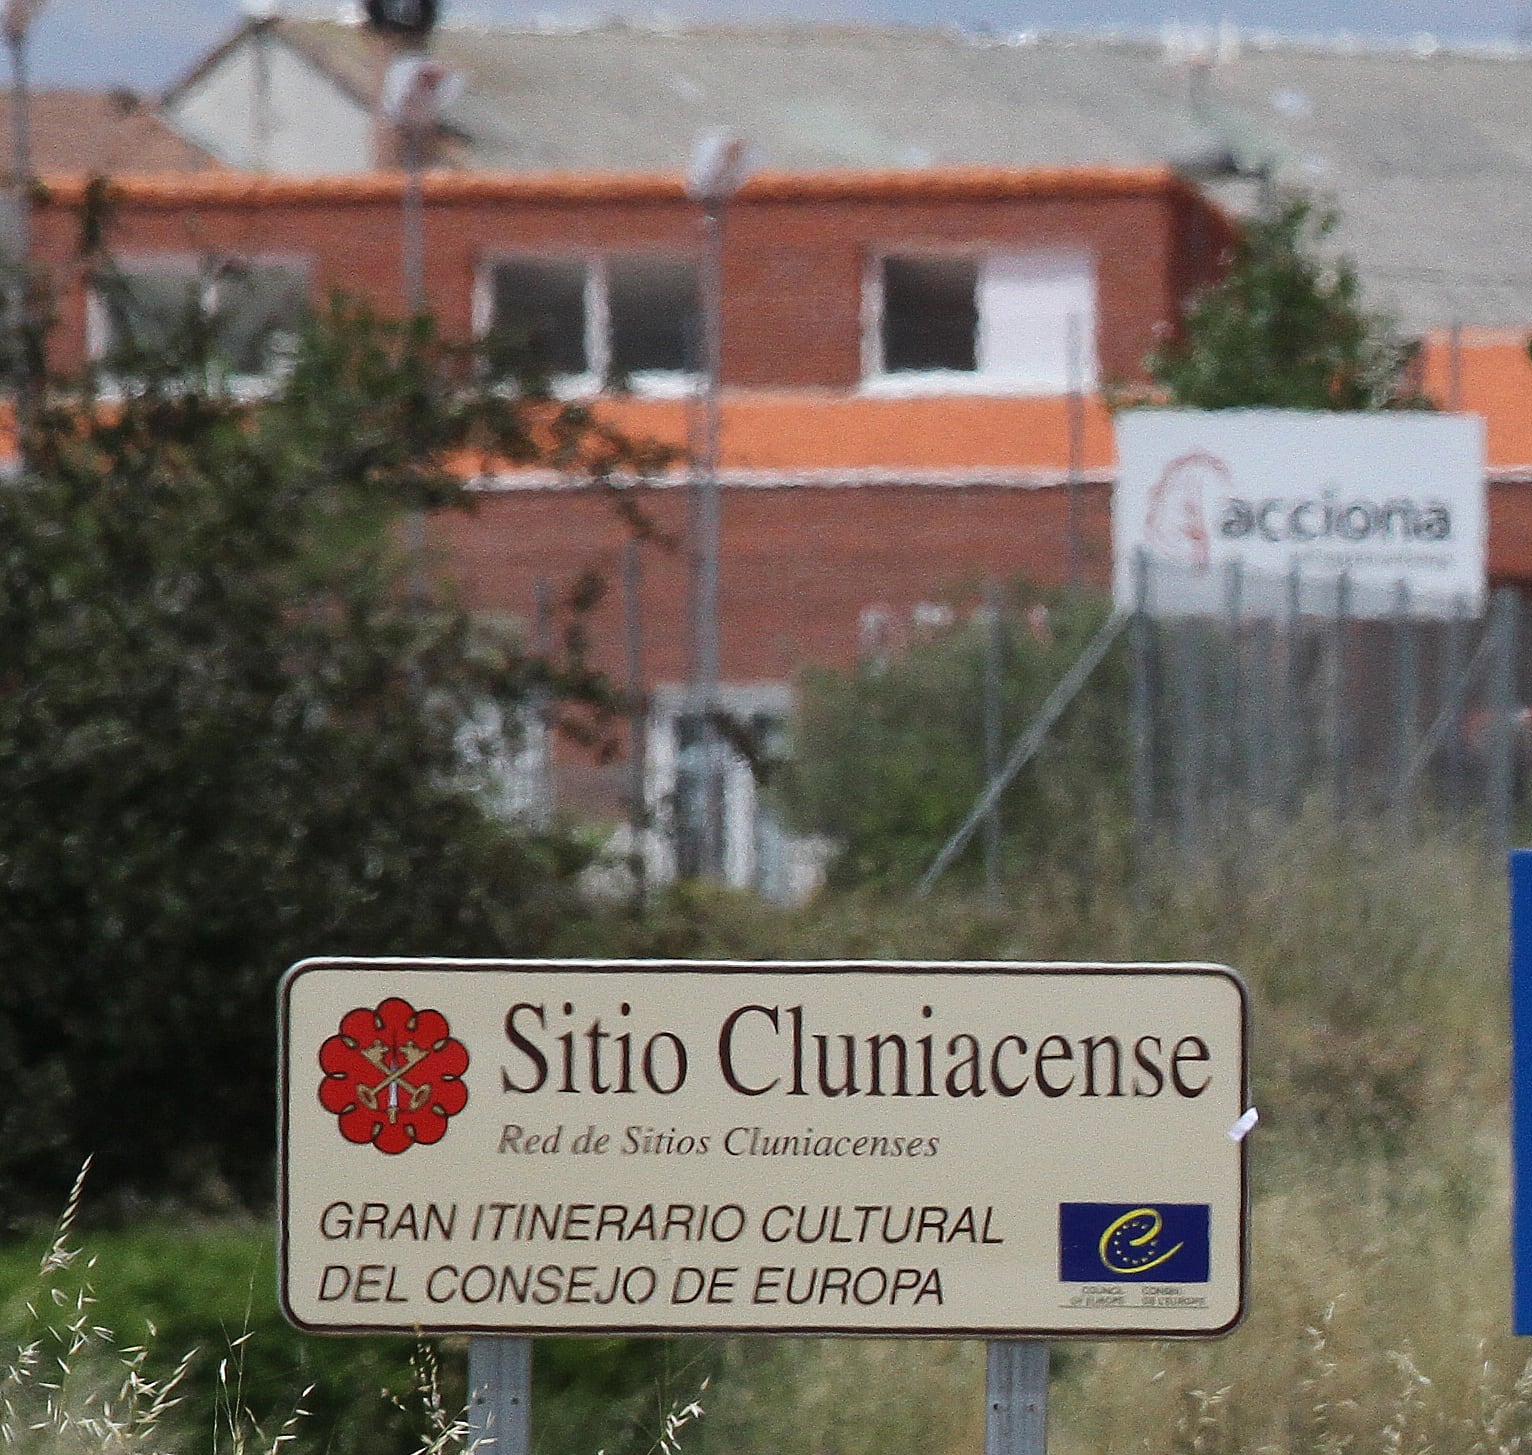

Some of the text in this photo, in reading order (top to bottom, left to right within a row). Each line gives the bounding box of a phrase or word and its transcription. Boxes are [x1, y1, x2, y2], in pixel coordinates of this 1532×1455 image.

[1218, 483, 1452, 543] acciona
[500, 1001, 1212, 1099] Sitio Cluniacense
[497, 1124, 940, 1159] Red de Sitios Cluniacenses
[319, 1201, 1005, 1246] GRAN ITINERARIO CULTURAL
[317, 1264, 944, 1307] DEL CONSEJO DE EUROPA
